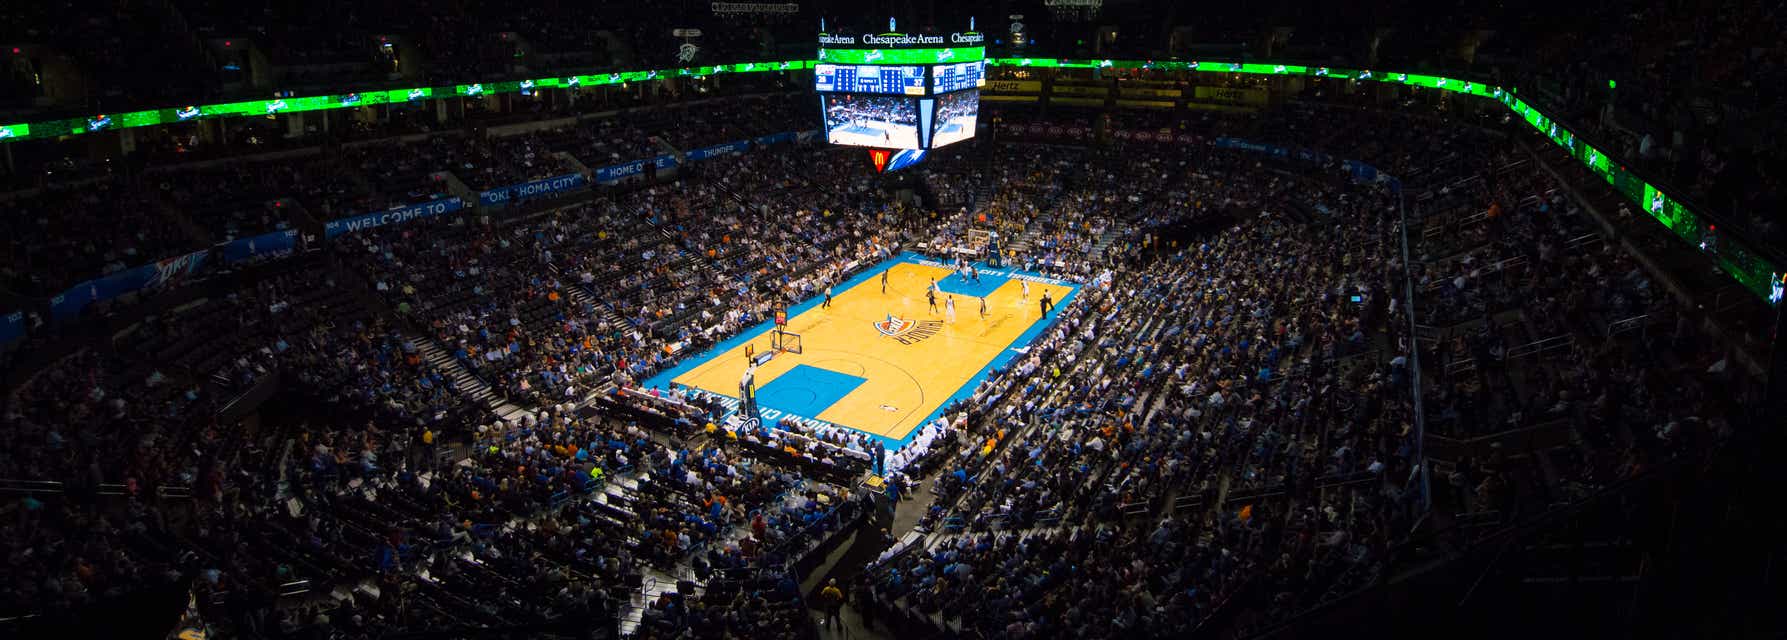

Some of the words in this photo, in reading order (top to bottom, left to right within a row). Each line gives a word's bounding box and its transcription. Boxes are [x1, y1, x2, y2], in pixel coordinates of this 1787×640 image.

[834, 34, 855, 44] Arena
[863, 34, 917, 48] Chesapeake
[917, 34, 944, 44] Arena
[992, 81, 1020, 90] Hertz
[610, 166, 634, 177] HOME
[490, 182, 550, 202] OKLHOMA
[552, 177, 576, 190] CITY
[347, 207, 422, 232] WELCOME
[427, 203, 445, 214] TO
